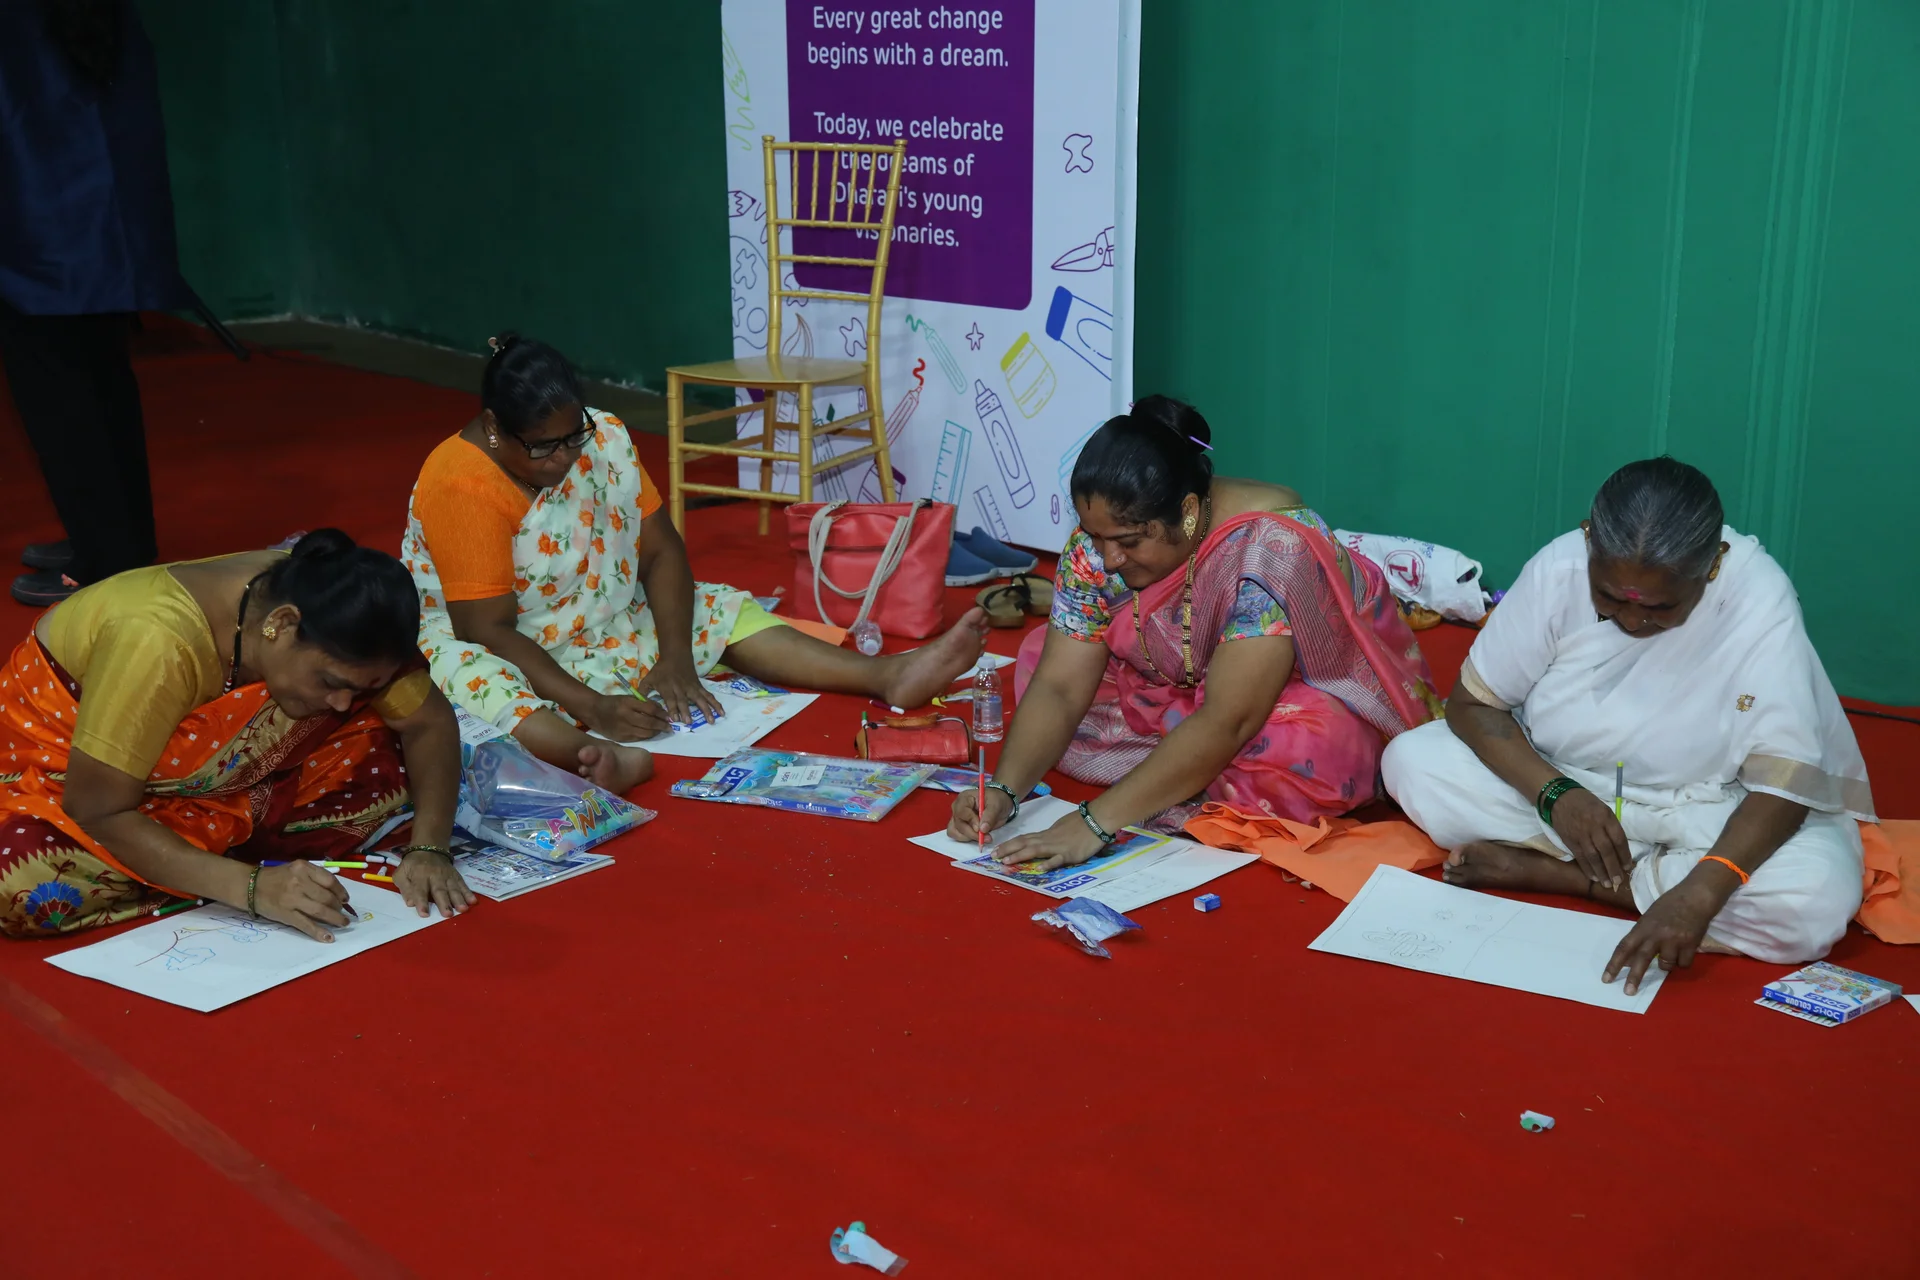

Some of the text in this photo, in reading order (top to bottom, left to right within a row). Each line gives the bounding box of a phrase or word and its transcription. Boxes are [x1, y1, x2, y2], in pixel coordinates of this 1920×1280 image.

[813, 6, 1003, 34] Every great change
[807, 42, 1009, 69] begins with a dream.
[813, 111, 1004, 142] Today, we celebrate
[841, 151, 975, 176] the deams of
[835, 182, 983, 218] Dharai's young
[1813, 1005, 1840, 1019] DOMS
